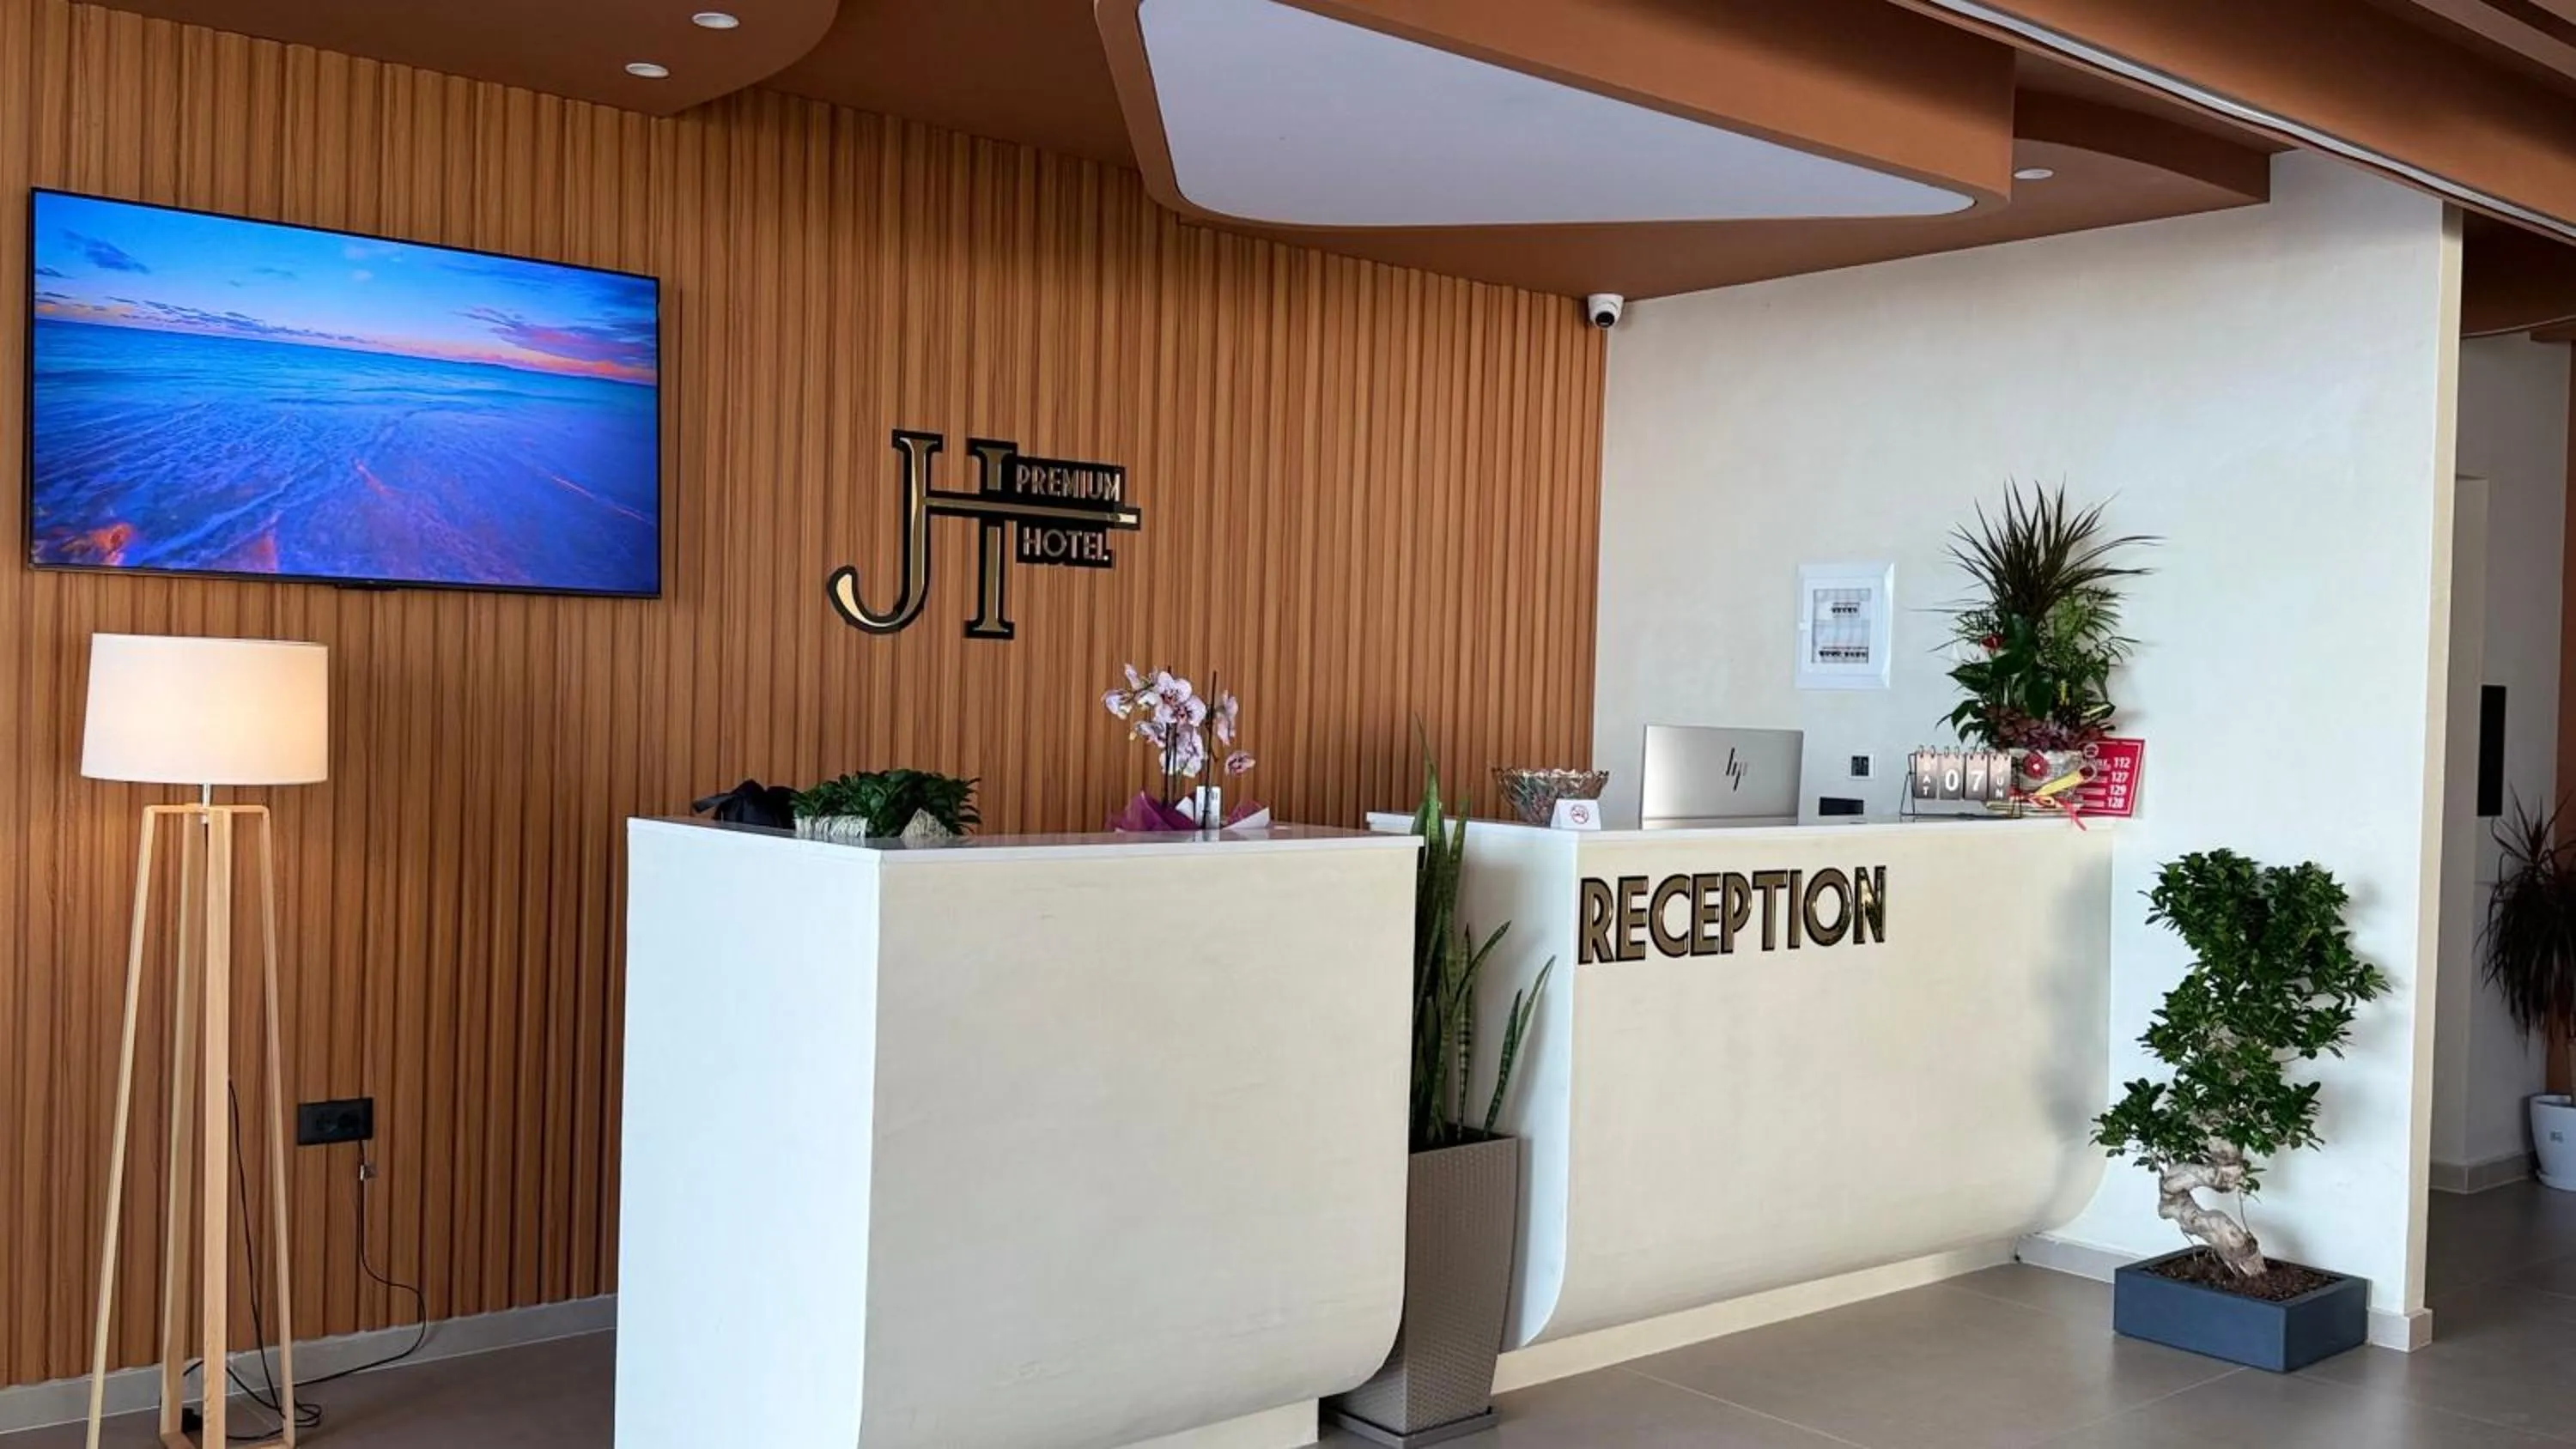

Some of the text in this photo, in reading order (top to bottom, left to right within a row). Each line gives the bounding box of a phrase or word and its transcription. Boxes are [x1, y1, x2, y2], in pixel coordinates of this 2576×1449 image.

[1016, 464, 1121, 502] PREMIUM
[1023, 526, 1109, 561] HOTEL
[1726, 747, 1747, 791] hp
[2113, 756, 2131, 769] 112
[1579, 865, 1886, 964] RECEPTION
